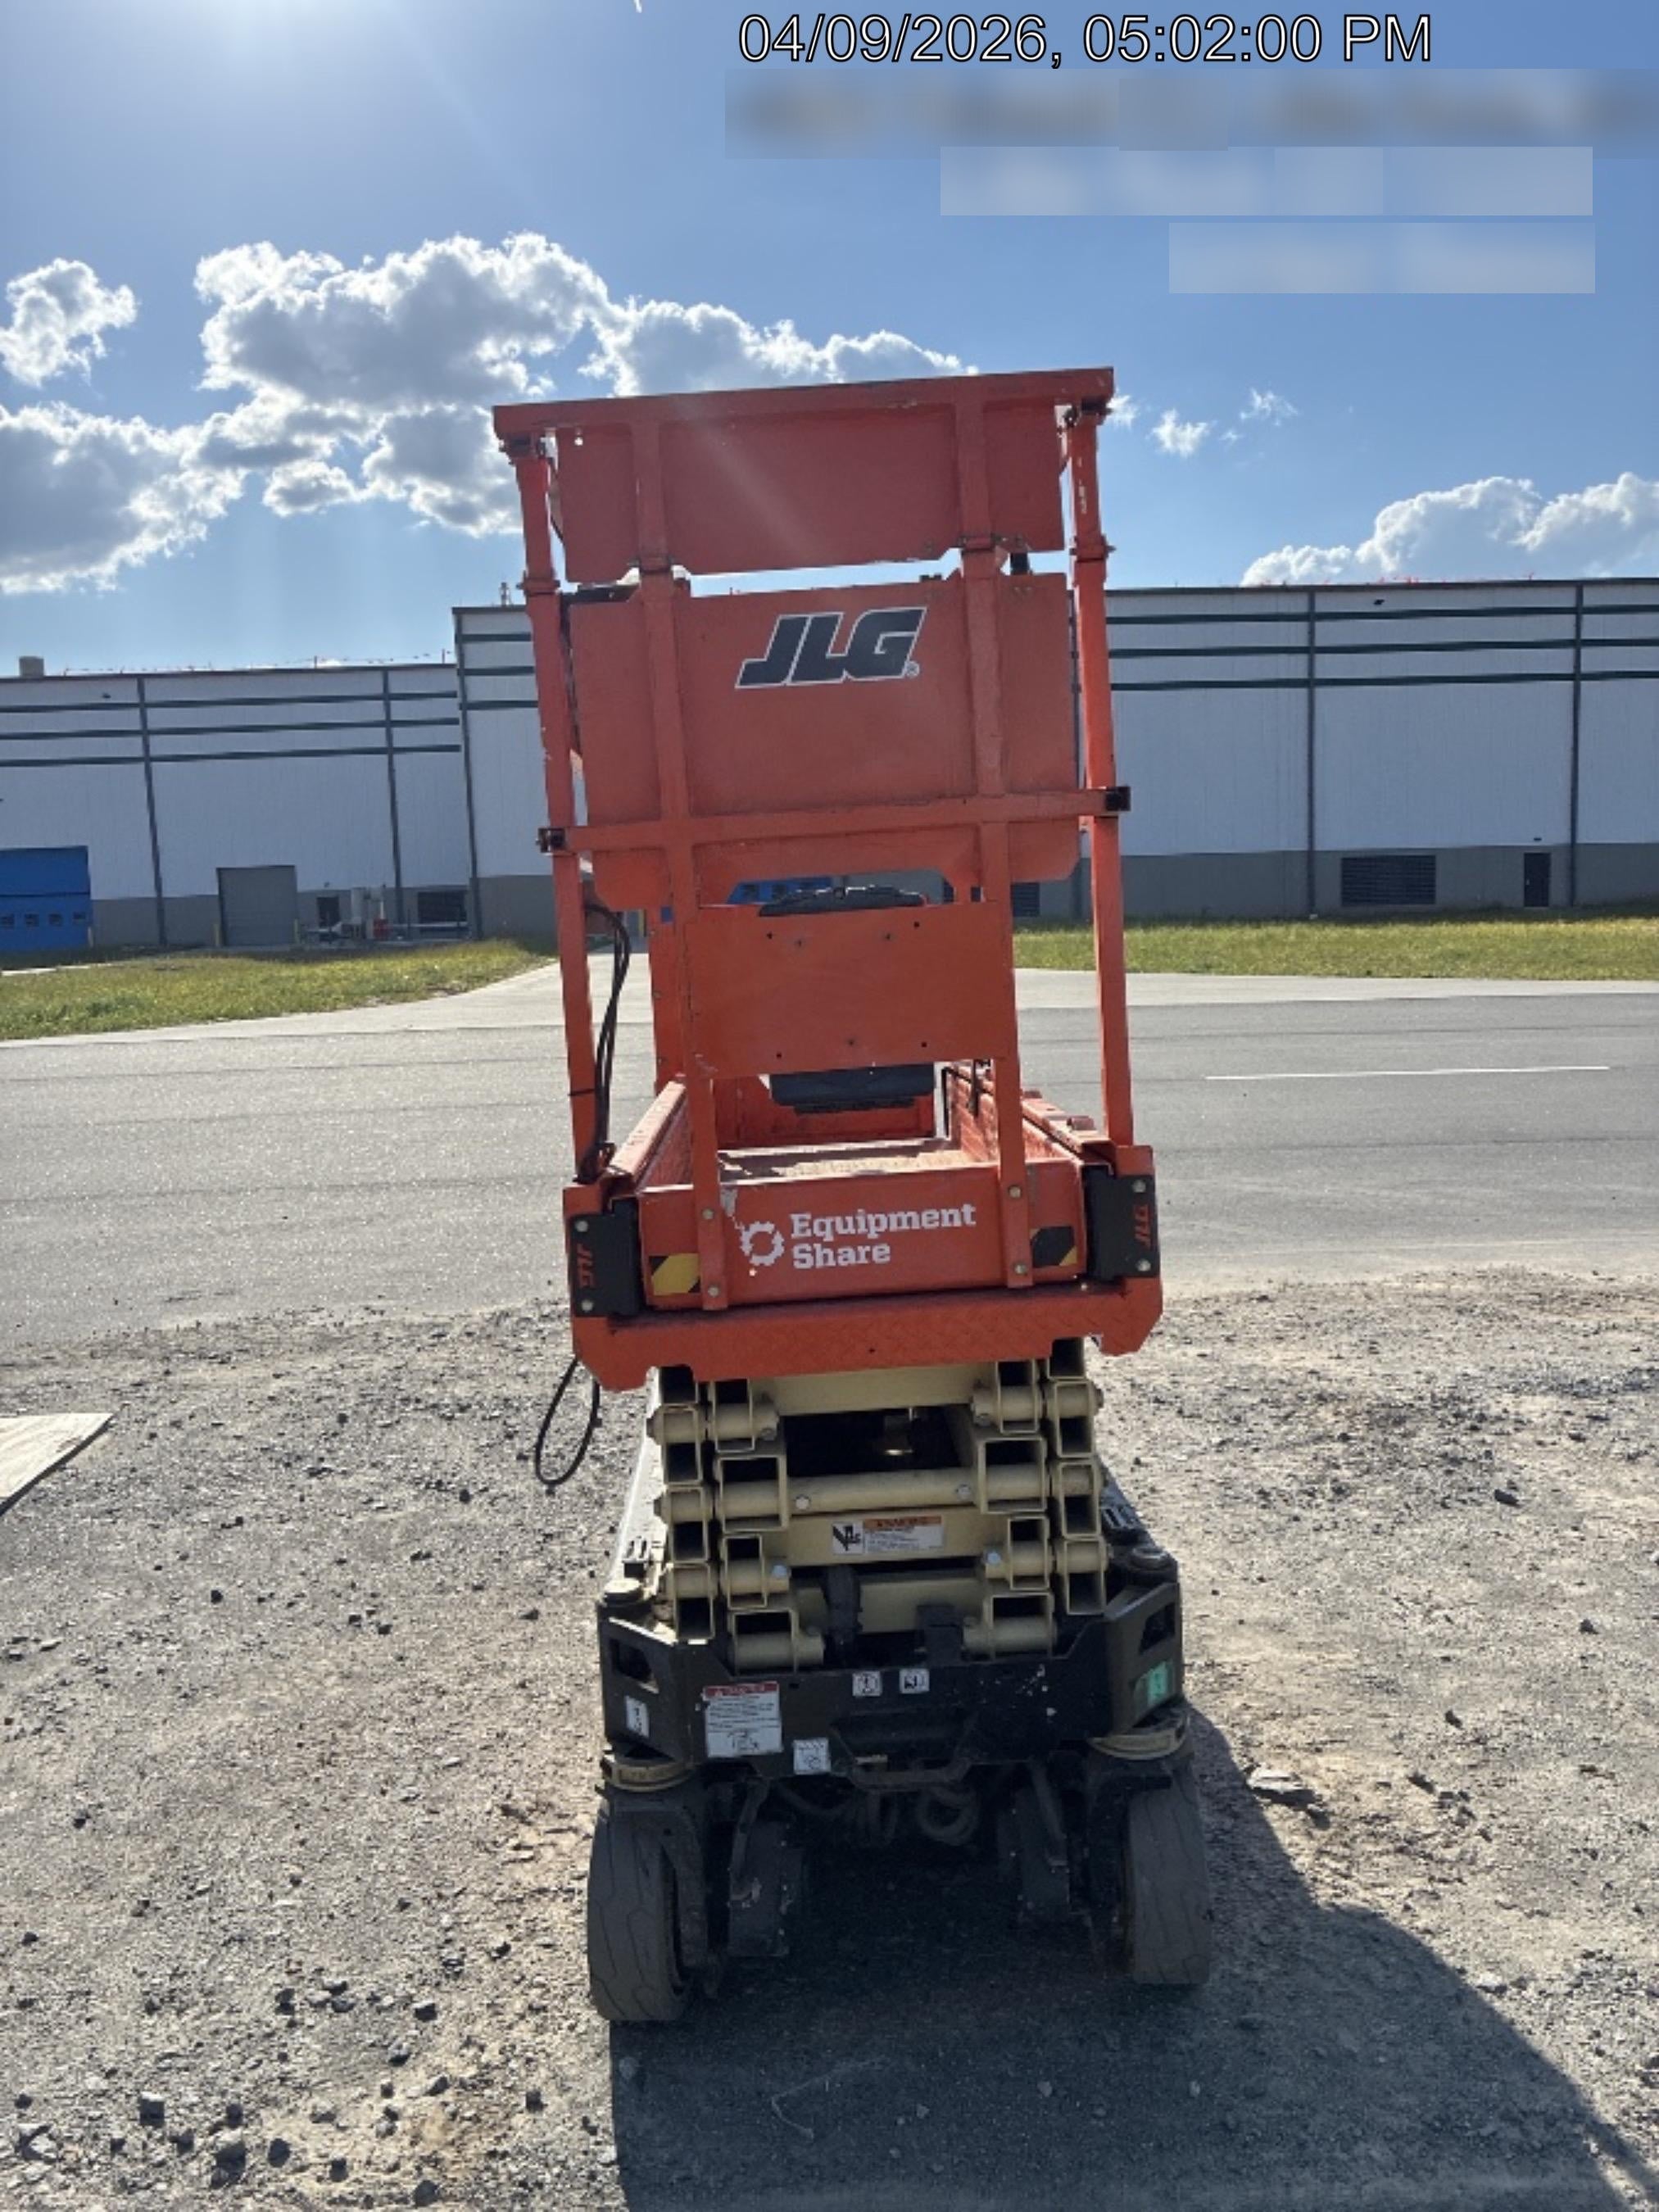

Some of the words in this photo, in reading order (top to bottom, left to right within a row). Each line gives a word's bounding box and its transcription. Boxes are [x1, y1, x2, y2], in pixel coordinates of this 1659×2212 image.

[735, 606, 927, 688] JLG
[790, 1203, 977, 1241] Equipment
[792, 1242, 891, 1269] Share
